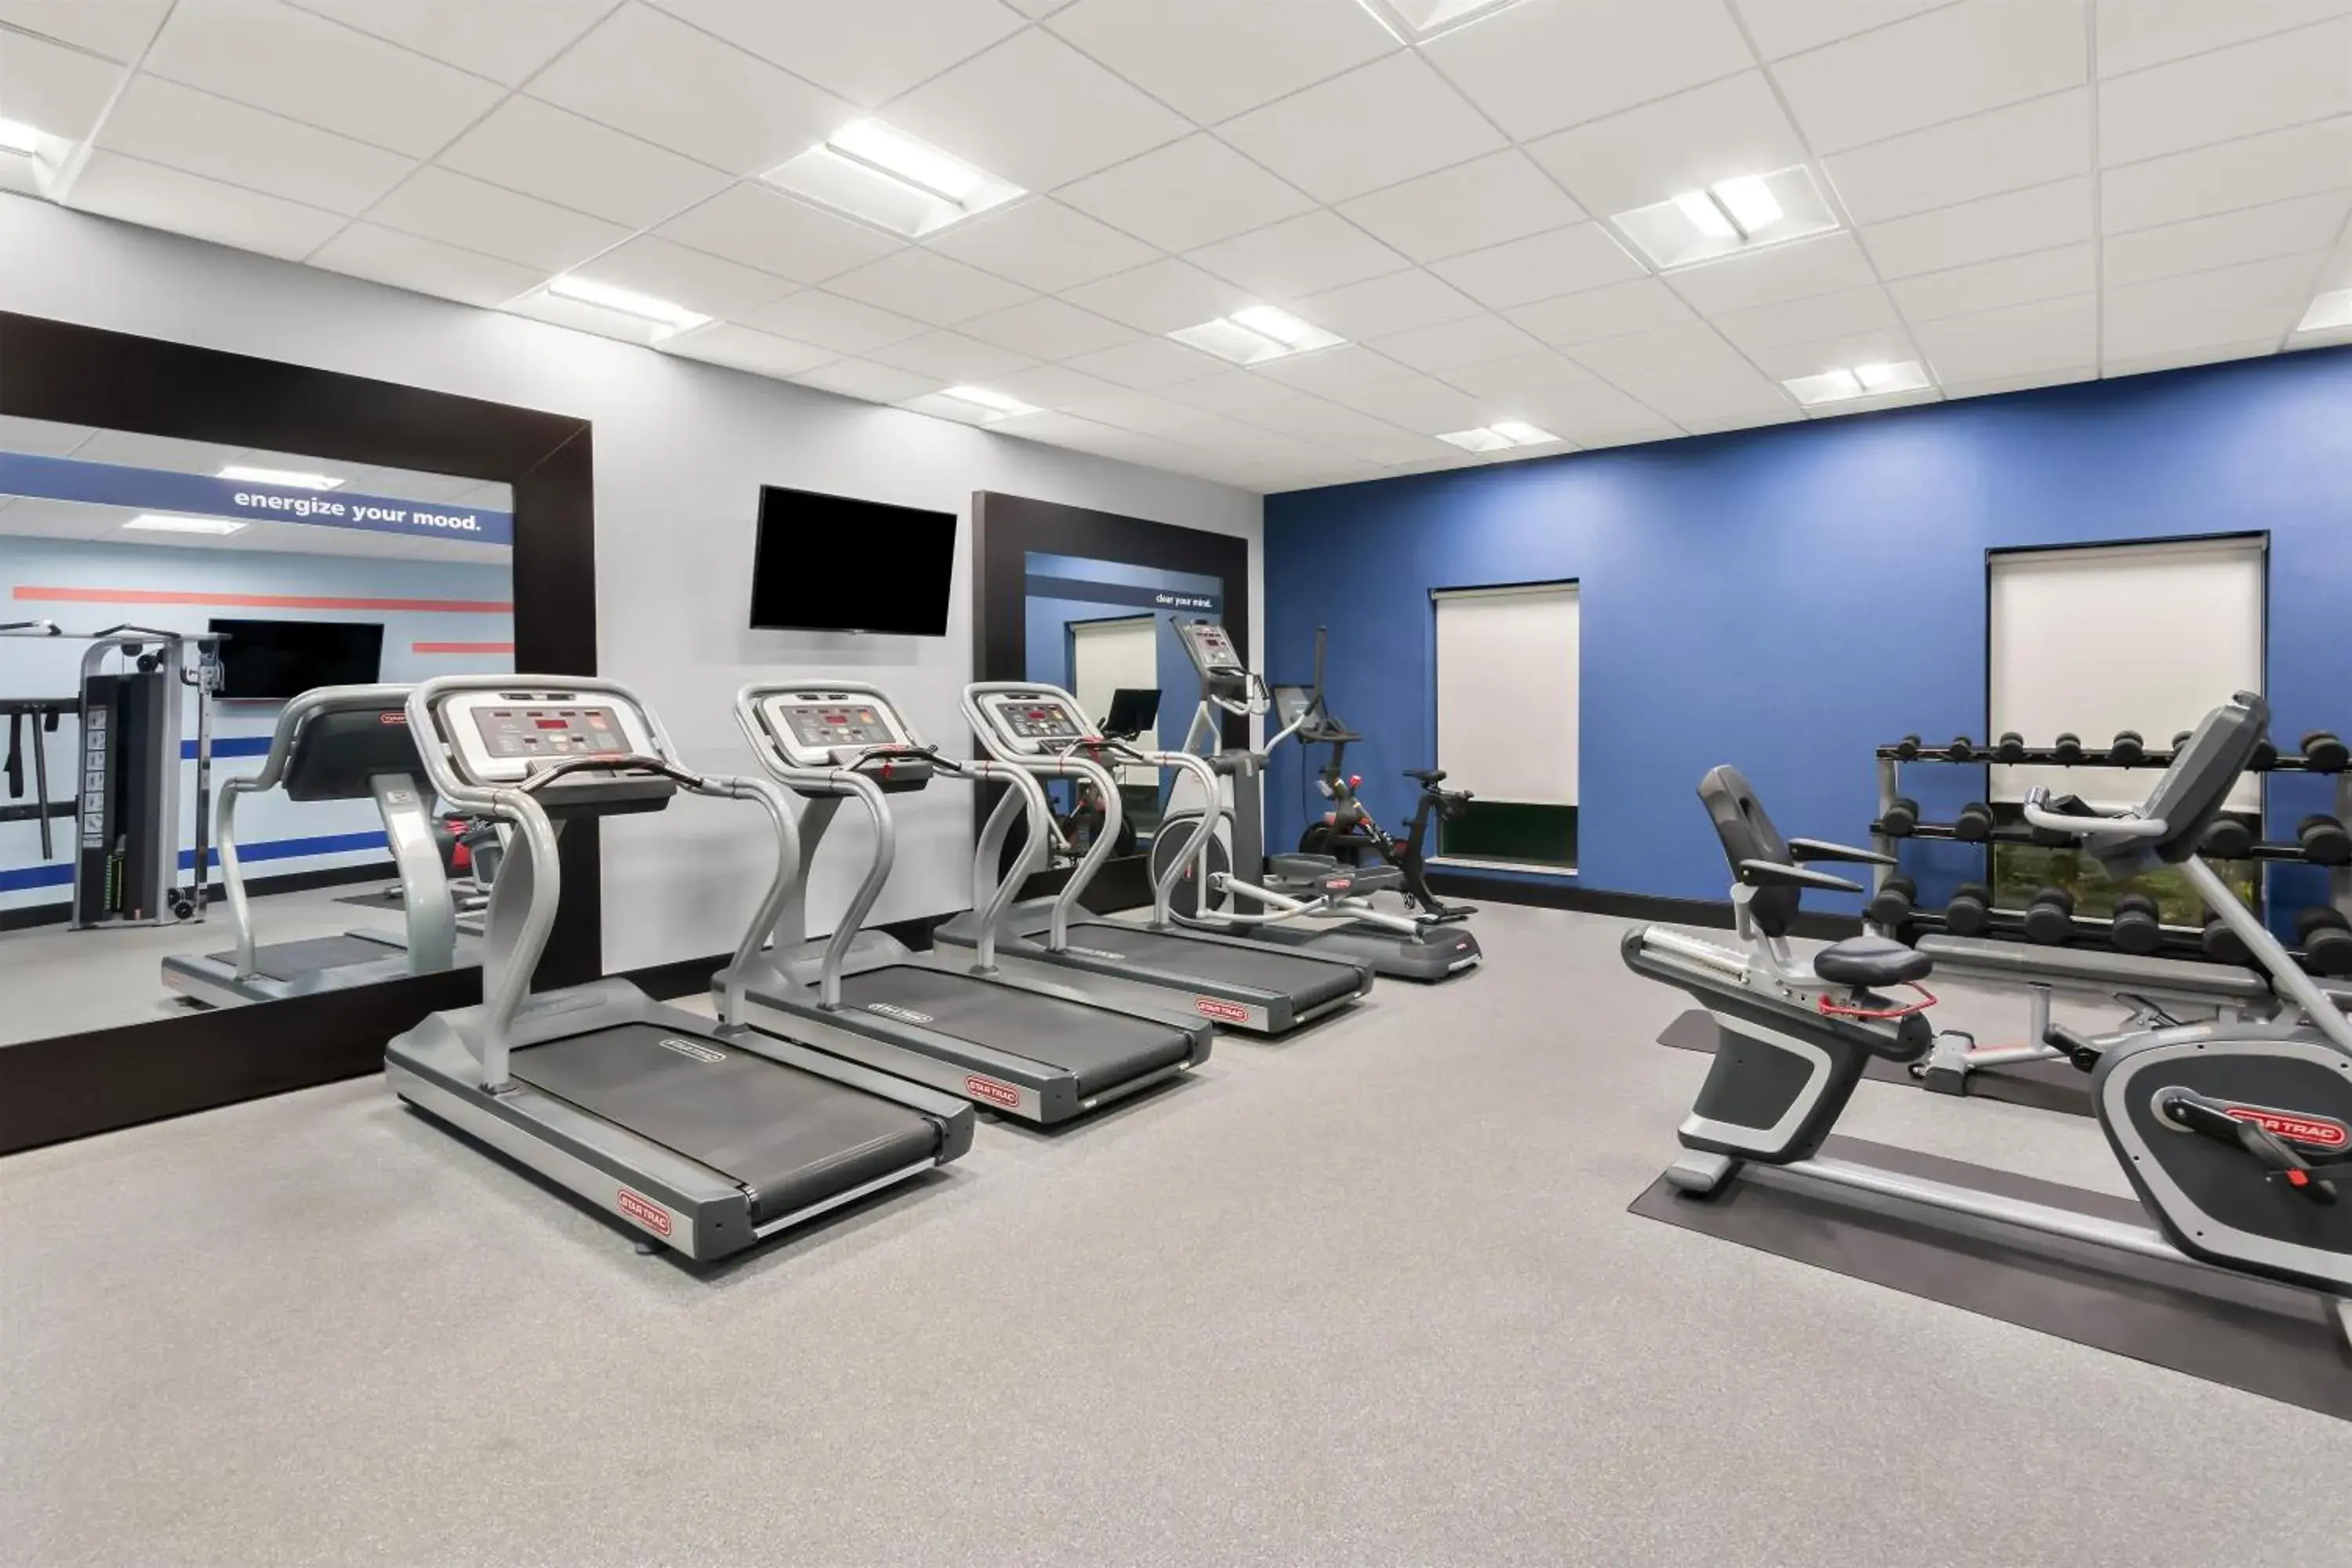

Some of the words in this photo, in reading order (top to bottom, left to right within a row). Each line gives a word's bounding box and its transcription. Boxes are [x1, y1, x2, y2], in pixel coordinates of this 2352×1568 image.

[234, 491, 346, 517] energize
[352, 506, 406, 522] your
[413, 511, 482, 531] mood.
[1156, 593, 1174, 604] clear
[1175, 597, 1191, 607] your
[1192, 597, 1212, 608] mind.
[969, 1081, 991, 1095] STAR
[991, 1087, 1014, 1102] TRAC
[2282, 1121, 2335, 1138] TRAC
[620, 1196, 642, 1216] STAR
[643, 1208, 666, 1229] TRAC
